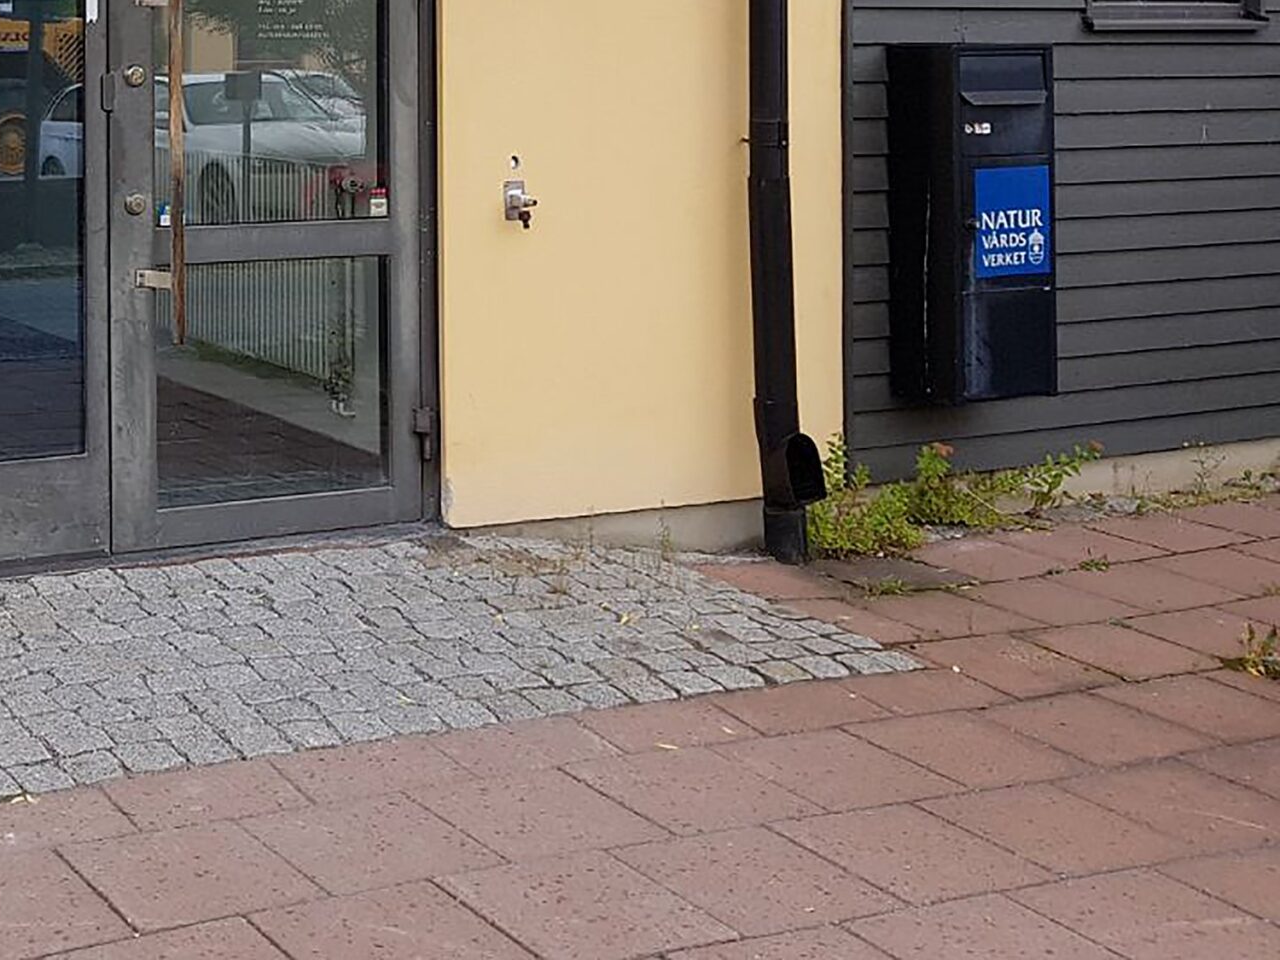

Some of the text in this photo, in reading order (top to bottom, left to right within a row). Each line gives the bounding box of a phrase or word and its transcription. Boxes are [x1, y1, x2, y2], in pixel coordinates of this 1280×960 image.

[982, 209, 1043, 230] NATUR
[982, 231, 1026, 249] VÅRDS
[982, 252, 1026, 267] VERKET
